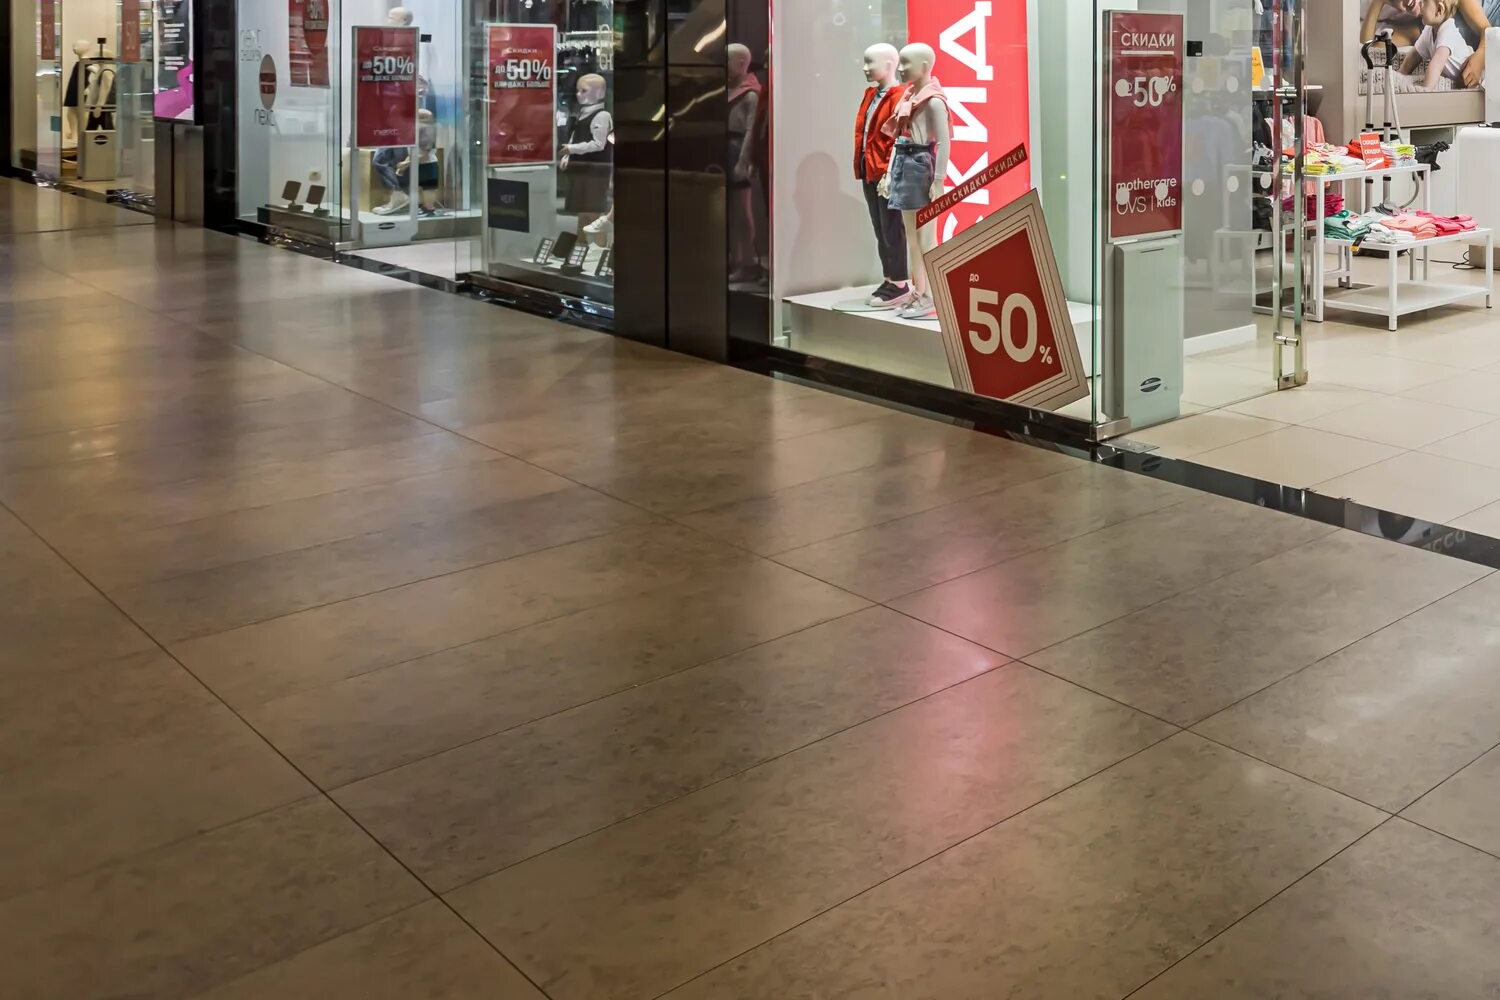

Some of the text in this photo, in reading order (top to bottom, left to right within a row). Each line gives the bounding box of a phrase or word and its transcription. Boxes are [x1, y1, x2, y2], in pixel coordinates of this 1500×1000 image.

[1121, 33, 1175, 48] СКИДКИ
[373, 55, 415, 75] 50%
[506, 59, 551, 80] 50%
[507, 143, 535, 152] next
[919, 149, 1025, 224] СКИДКИ СКИДКИ СКИДКИ
[1157, 196, 1177, 208] kids
[969, 272, 980, 283] ДО
